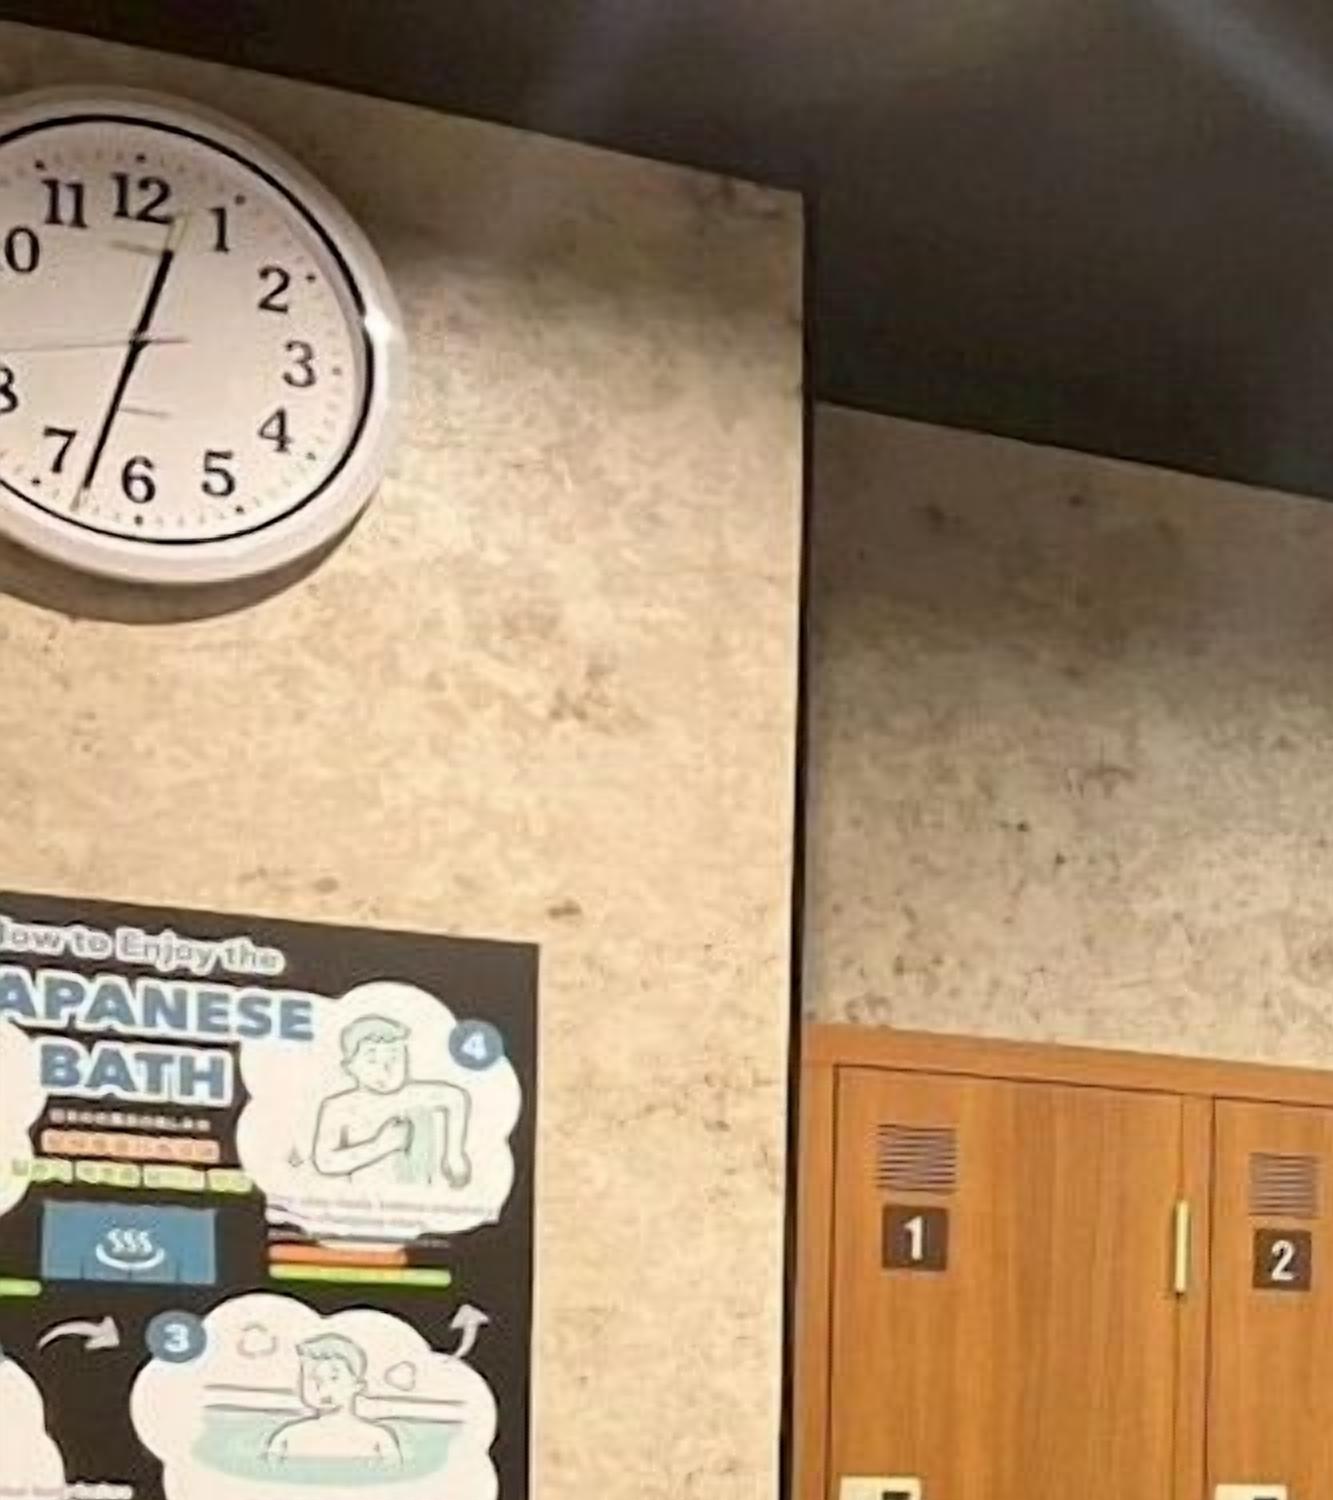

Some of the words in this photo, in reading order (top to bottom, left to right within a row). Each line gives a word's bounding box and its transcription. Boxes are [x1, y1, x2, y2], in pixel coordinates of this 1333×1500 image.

[43, 177, 87, 227] 11
[111, 172, 172, 224] 12
[0, 227, 40, 273] 0
[211, 207, 229, 252] 1
[258, 266, 291, 312] 2
[283, 341, 316, 387] 3
[43, 427, 77, 474] 7
[259, 407, 293, 452] 4
[121, 456, 156, 503] 6
[201, 450, 236, 497] 5
[75, 930, 108, 953] to
[123, 934, 214, 969] Enjoy
[224, 942, 278, 969] the
[0, 974, 314, 1040] APANESE
[462, 1037, 487, 1059] 4
[41, 1044, 224, 1099] BATH
[905, 1216, 924, 1260] 1
[1271, 1240, 1295, 1281] 2
[164, 1326, 188, 1351] 3
